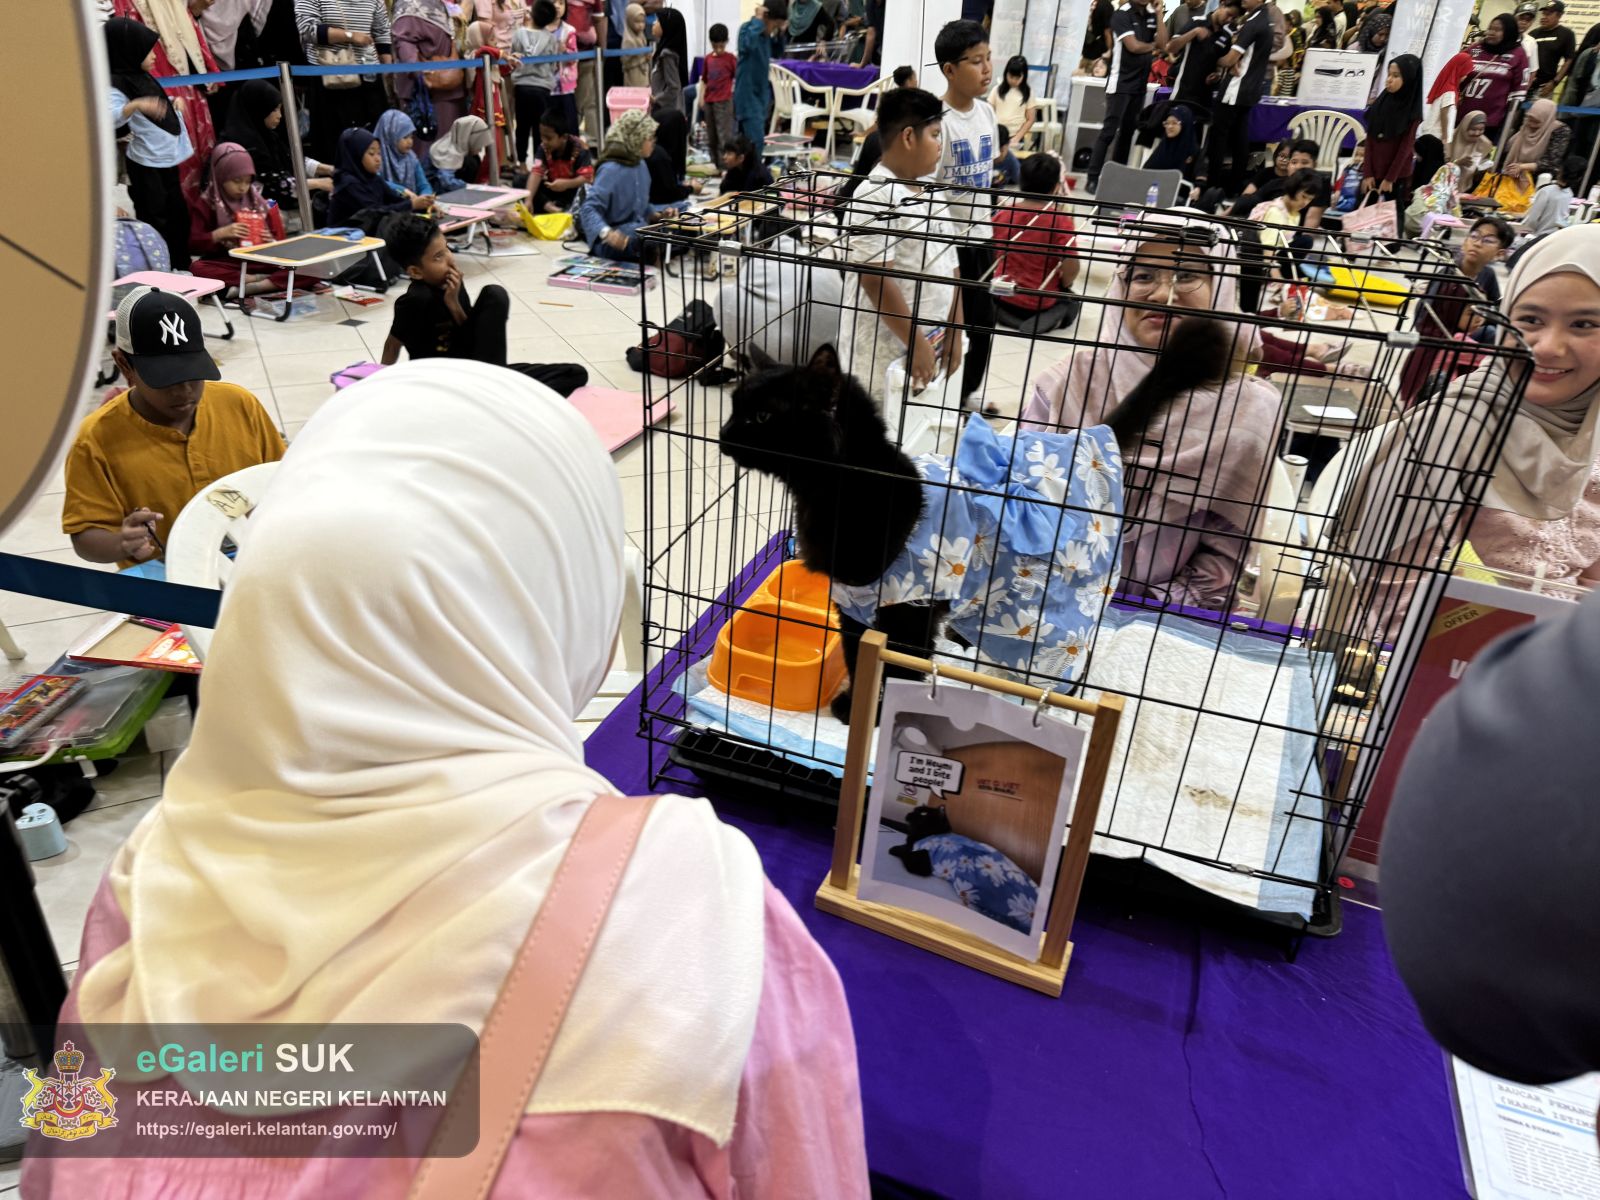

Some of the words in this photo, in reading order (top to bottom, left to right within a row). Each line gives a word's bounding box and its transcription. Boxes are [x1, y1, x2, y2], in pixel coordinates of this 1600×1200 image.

[1465, 78, 1494, 99] 07
[158, 312, 189, 346] NY
[1443, 609, 1480, 629] OFFER
[910, 756, 924, 766] I'm
[908, 766, 925, 775] and
[926, 768, 933, 776] I
[933, 770, 952, 780] bite
[912, 776, 945, 787] people!
